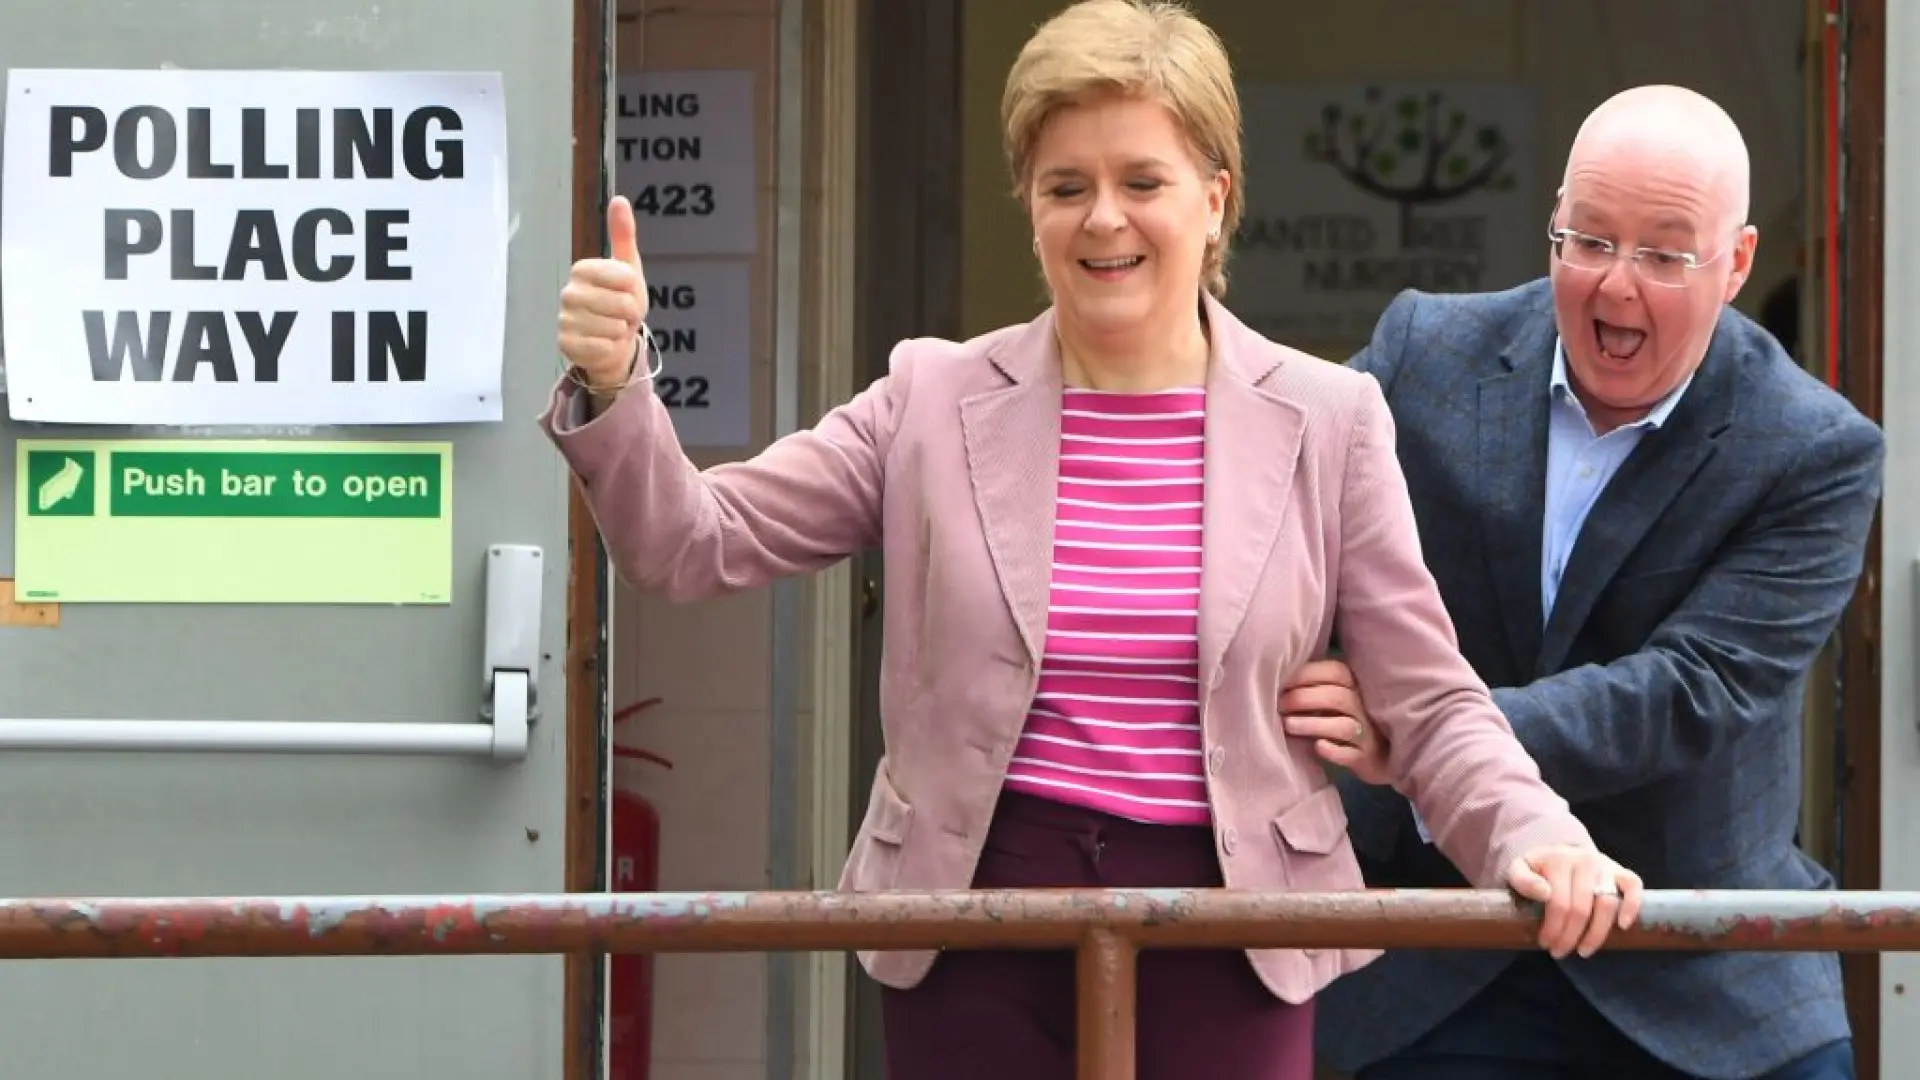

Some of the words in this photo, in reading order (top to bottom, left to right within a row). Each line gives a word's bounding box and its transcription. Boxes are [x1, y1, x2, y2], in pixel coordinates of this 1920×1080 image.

[618, 93, 700, 119] LING
[48, 104, 464, 181] POLLING
[617, 137, 701, 162] TION
[634, 183, 715, 217] 423
[104, 207, 413, 283] PLACE
[648, 285, 696, 310] NG
[82, 310, 299, 382] WAY
[331, 309, 428, 383] IN
[657, 376, 710, 408] 22
[123, 467, 206, 496] Push
[220, 468, 277, 497] bar
[292, 471, 327, 497] to
[342, 475, 428, 502] open
